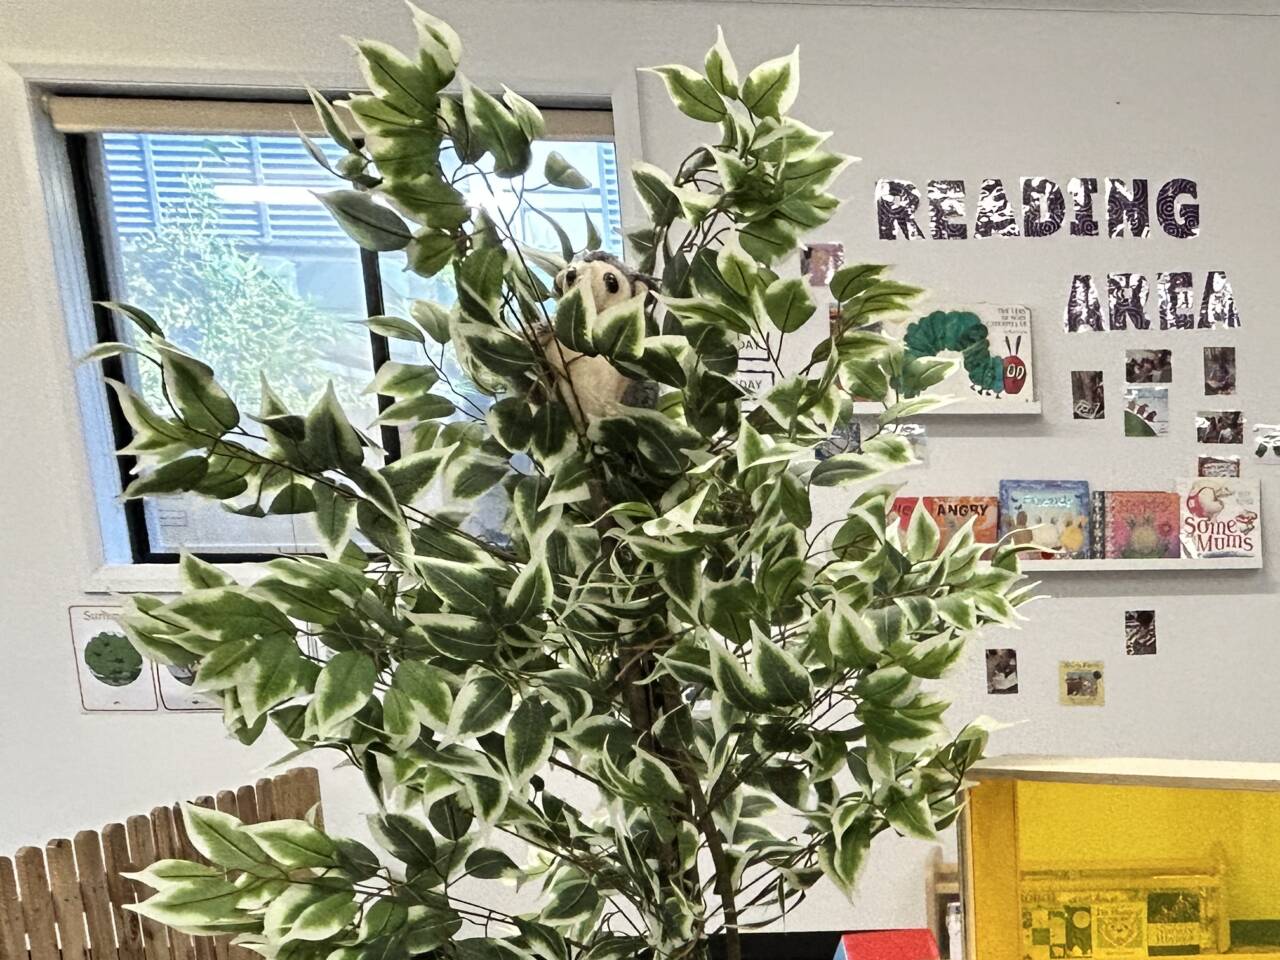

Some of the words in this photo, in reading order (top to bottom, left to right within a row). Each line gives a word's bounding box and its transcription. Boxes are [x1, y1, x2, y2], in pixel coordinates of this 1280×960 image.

[875, 176, 1200, 241] READING
[1064, 271, 1242, 333] AREA
[936, 503, 990, 517] ANGRY
[1184, 516, 1237, 536] Some
[1197, 533, 1254, 552] Mums
